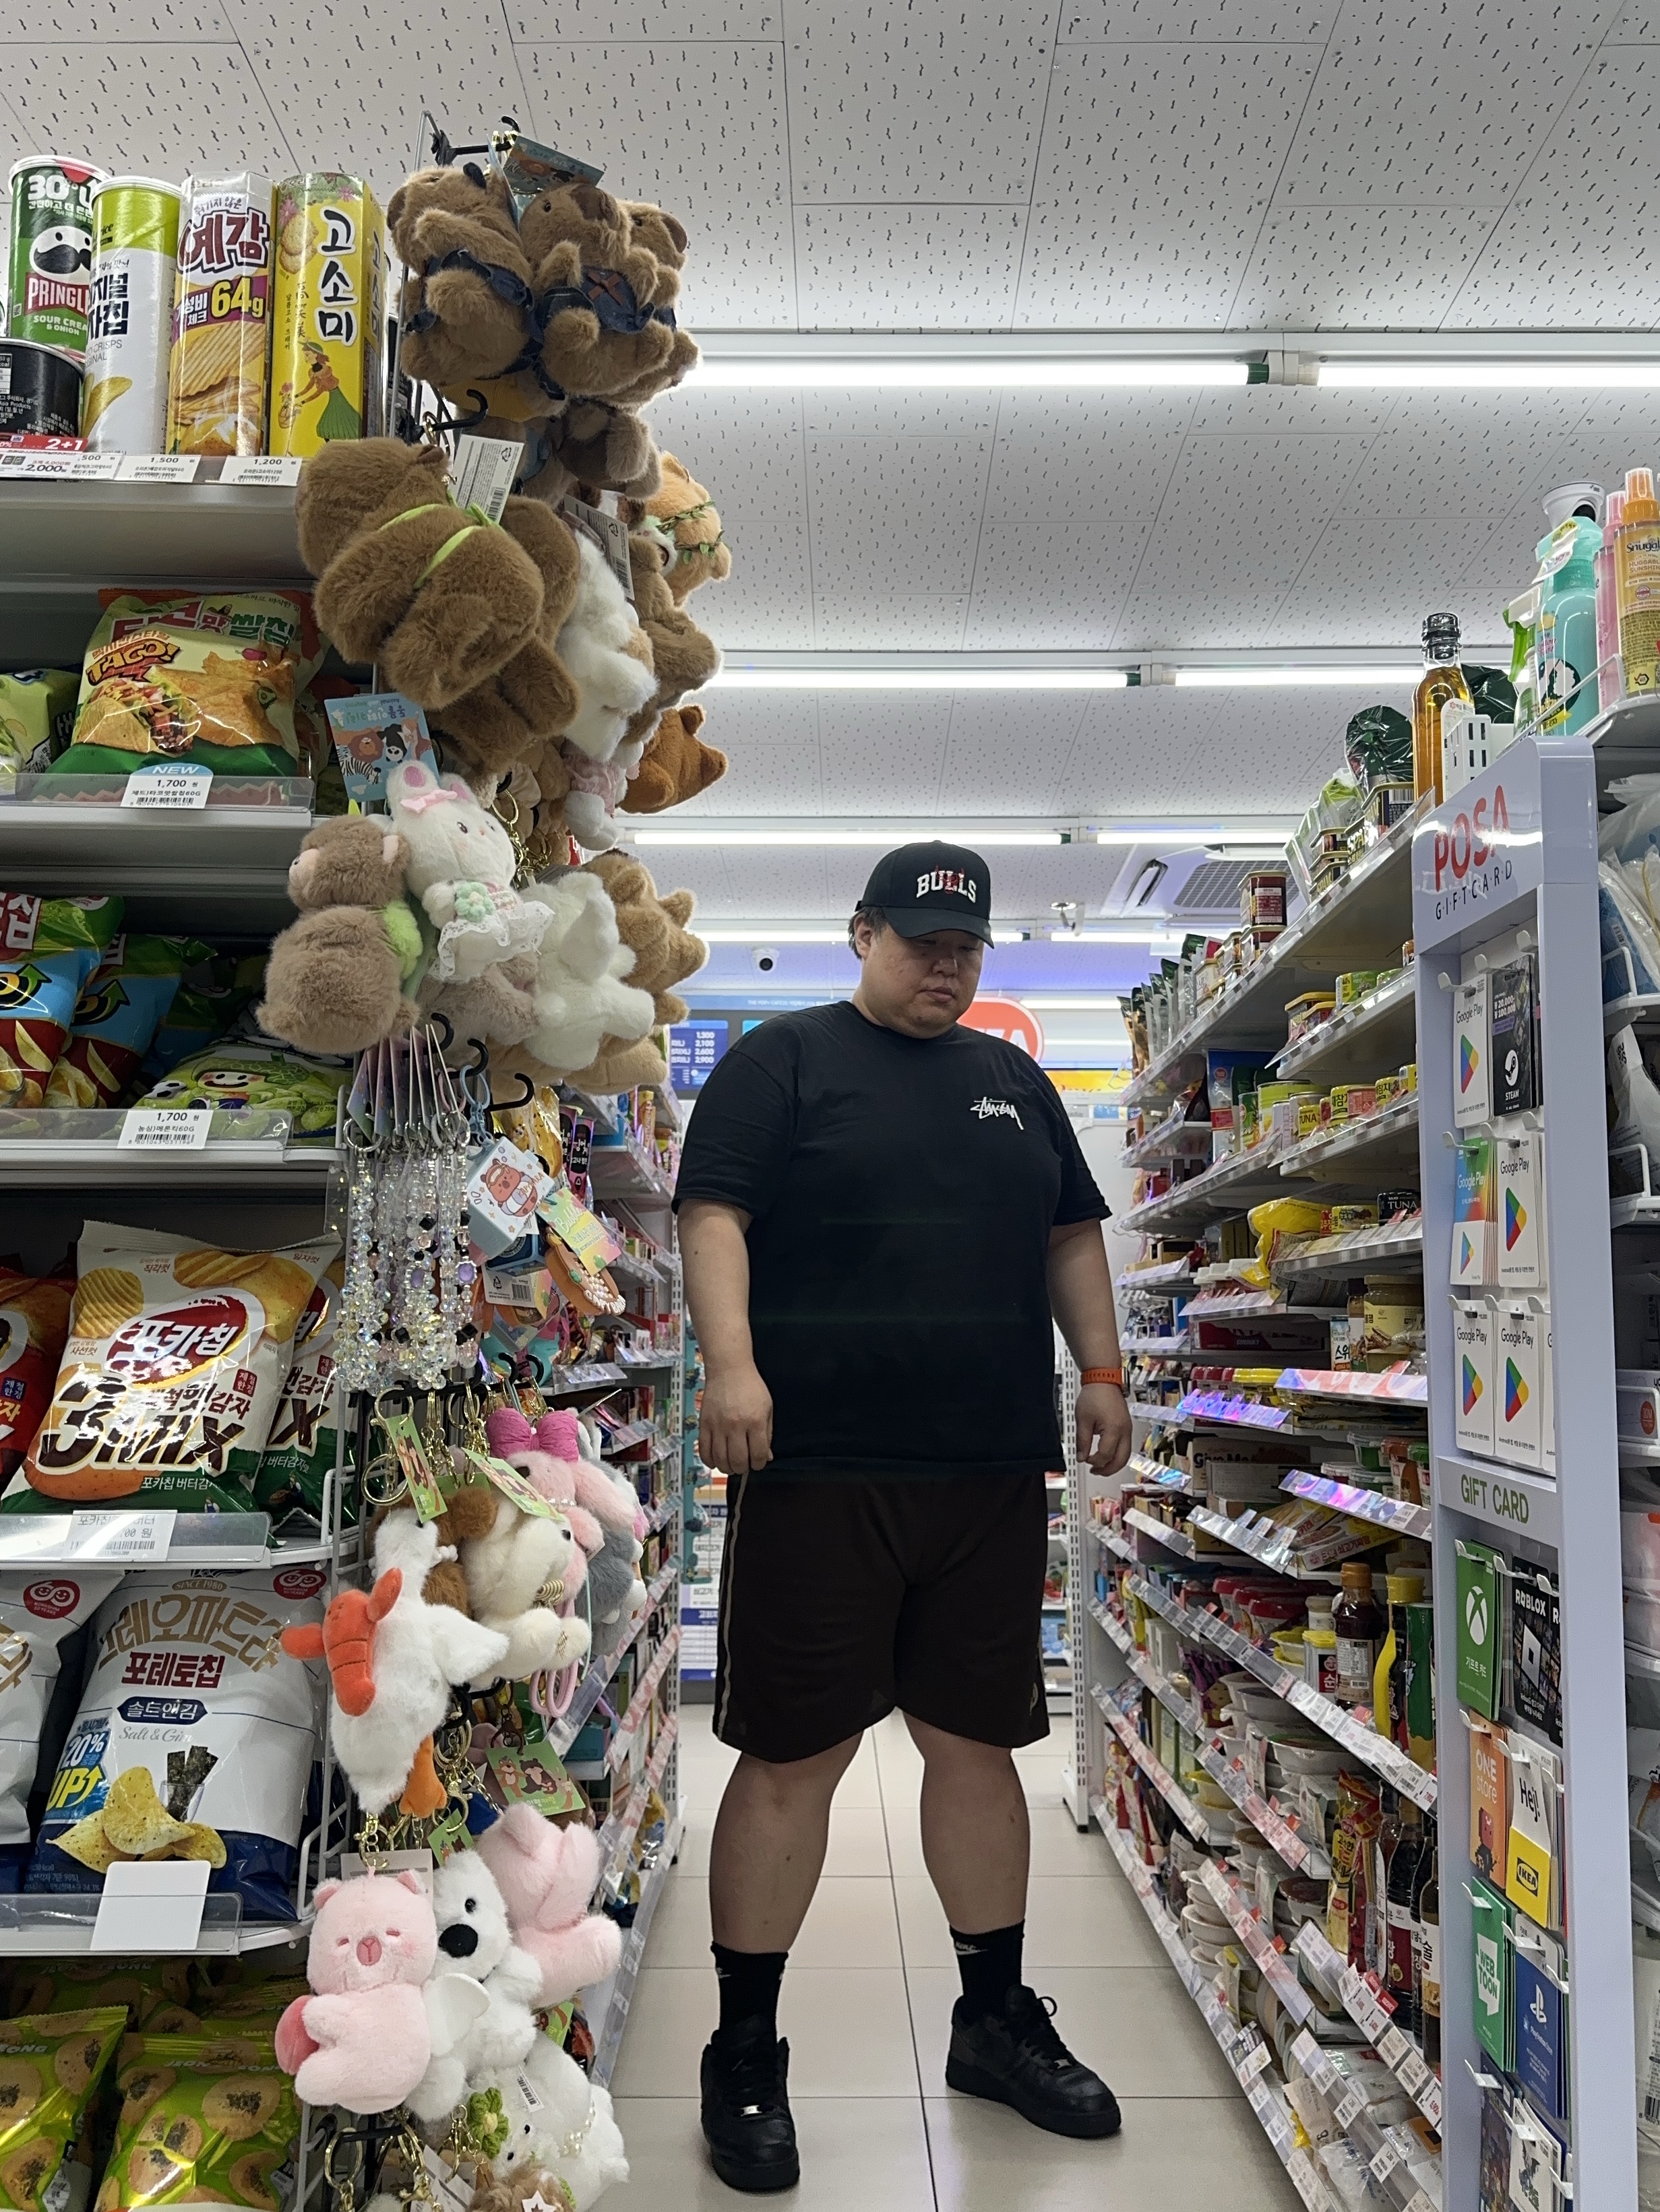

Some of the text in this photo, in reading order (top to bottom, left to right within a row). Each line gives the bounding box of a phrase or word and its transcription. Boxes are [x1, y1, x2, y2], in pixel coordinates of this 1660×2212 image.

[178, 208, 270, 271] 예감
[317, 208, 357, 345] 고소미
[28, 278, 90, 315] PRINGL
[211, 276, 265, 318] 64g
[34, 314, 88, 330] SOUR CREA
[47, 323, 80, 336] & ONION
[94, 339, 123, 352] CRISPS
[44, 438, 84, 450] 2+1
[1626, 538, 1660, 553] Snuggl
[152, 766, 199, 774] NEW
[157, 780, 187, 788] 1,700
[1434, 784, 1510, 893] POSA
[917, 870, 977, 903] BULLS
[1456, 1003, 1483, 1024] Google Play
[1505, 1089, 1519, 1101] STEAM
[157, 1113, 187, 1122] 1,700
[1299, 1112, 1317, 1124] TUNA
[1501, 1157, 1529, 1176] Google Play
[1457, 1172, 1486, 1191] Google Play
[1387, 1200, 1417, 1210] TUNA
[115, 1319, 240, 1360] 포카칩
[1457, 1327, 1487, 1346] Google Play
[1501, 1327, 1533, 1350] Google Play
[141, 1477, 175, 1490] 포카칩
[1461, 1474, 1530, 1525] GIFT CARD
[141, 1527, 152, 1539] 원
[175, 1579, 224, 1592] SINCE 1980
[1515, 1588, 1546, 1617] ROBLOX
[121, 1651, 226, 1689] 포테토칩
[1465, 1656, 1479, 1674] 기프트
[127, 1699, 199, 1721] 솔트앤김
[119, 1726, 194, 1743] Salt & Gim
[63, 1732, 106, 1767] 20%
[1475, 1748, 1498, 1783] ONE
[47, 1767, 90, 1810] UP
[1476, 1775, 1498, 1804] store
[1519, 1777, 1541, 1823] Hej!
[1518, 1864, 1537, 1889] IKEA
[1479, 1949, 1495, 1978] WEB
[1478, 1965, 1498, 2000] TOON
